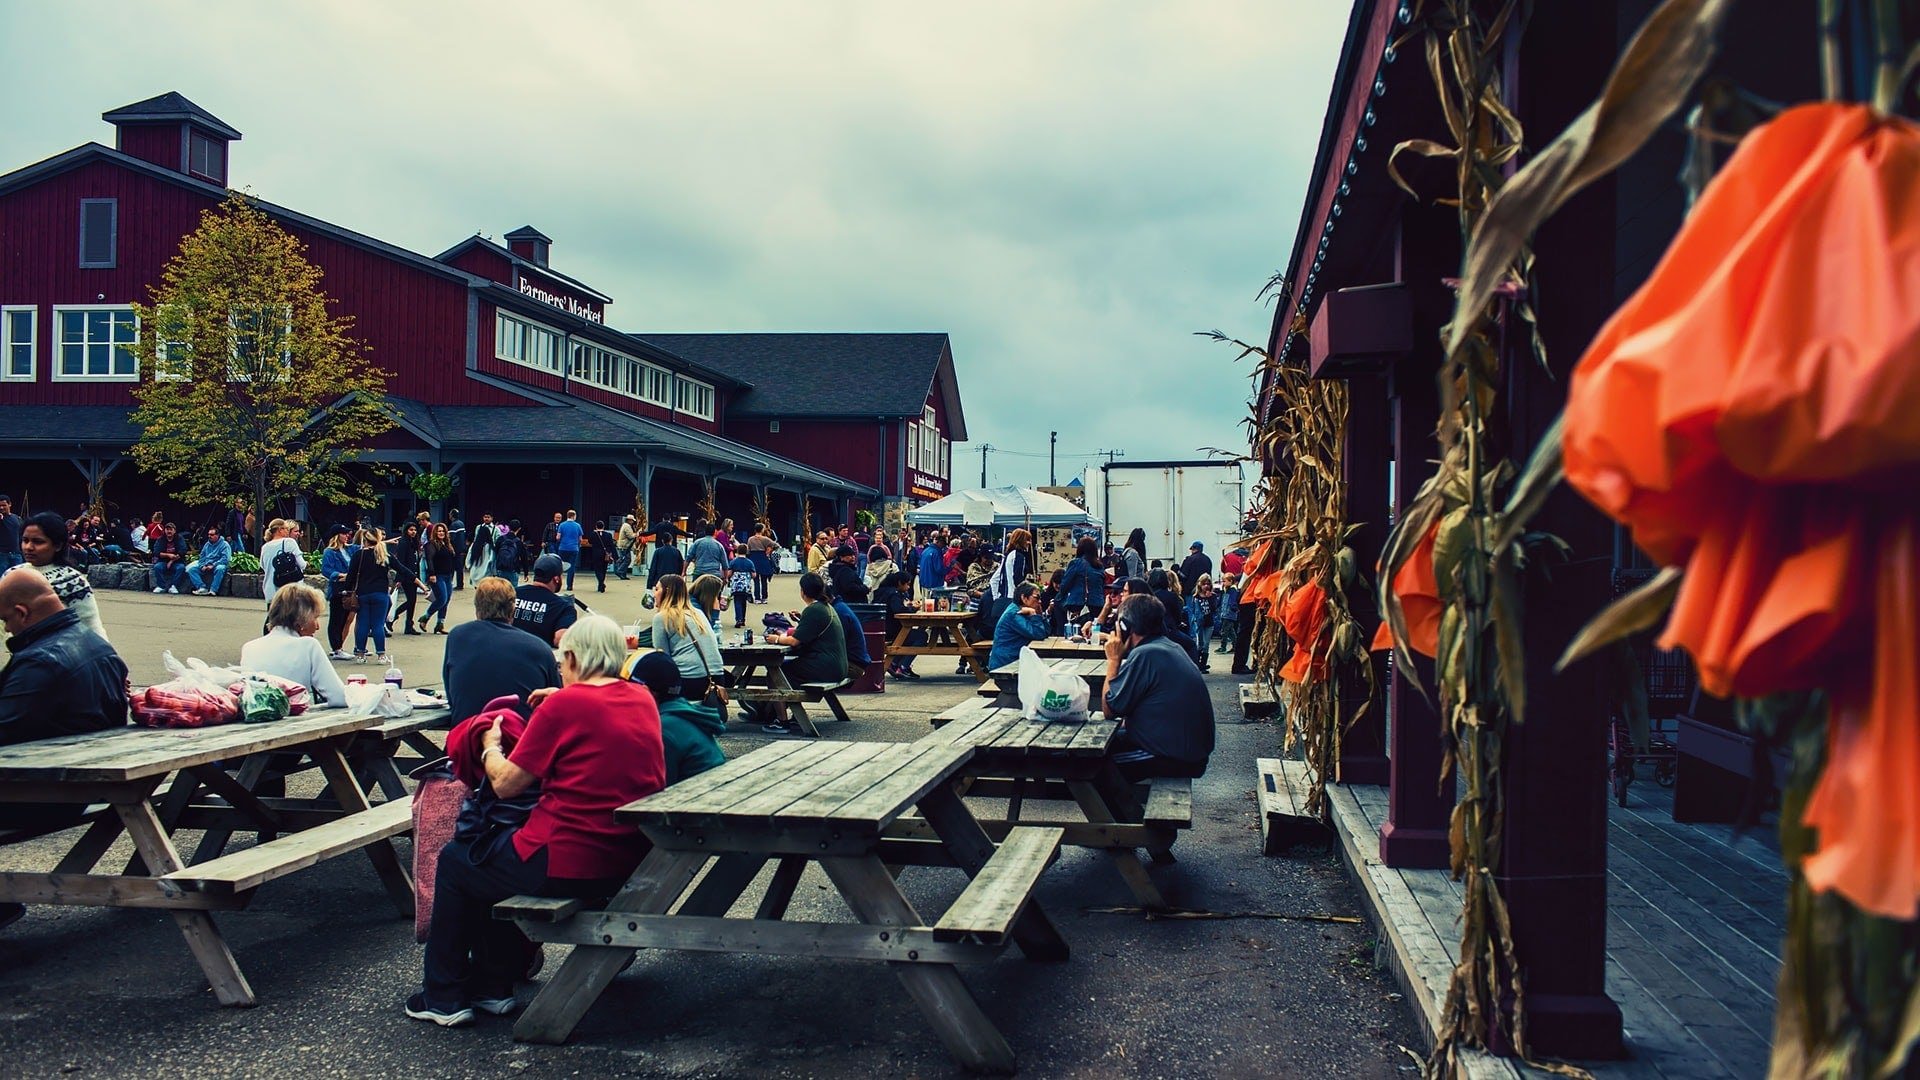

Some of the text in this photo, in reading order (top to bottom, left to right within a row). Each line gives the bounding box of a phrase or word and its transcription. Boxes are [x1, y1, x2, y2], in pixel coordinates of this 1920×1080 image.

[520, 276, 601, 325] Farmers' Market
[514, 598, 547, 613] ENECA
[513, 608, 544, 623] IRE
